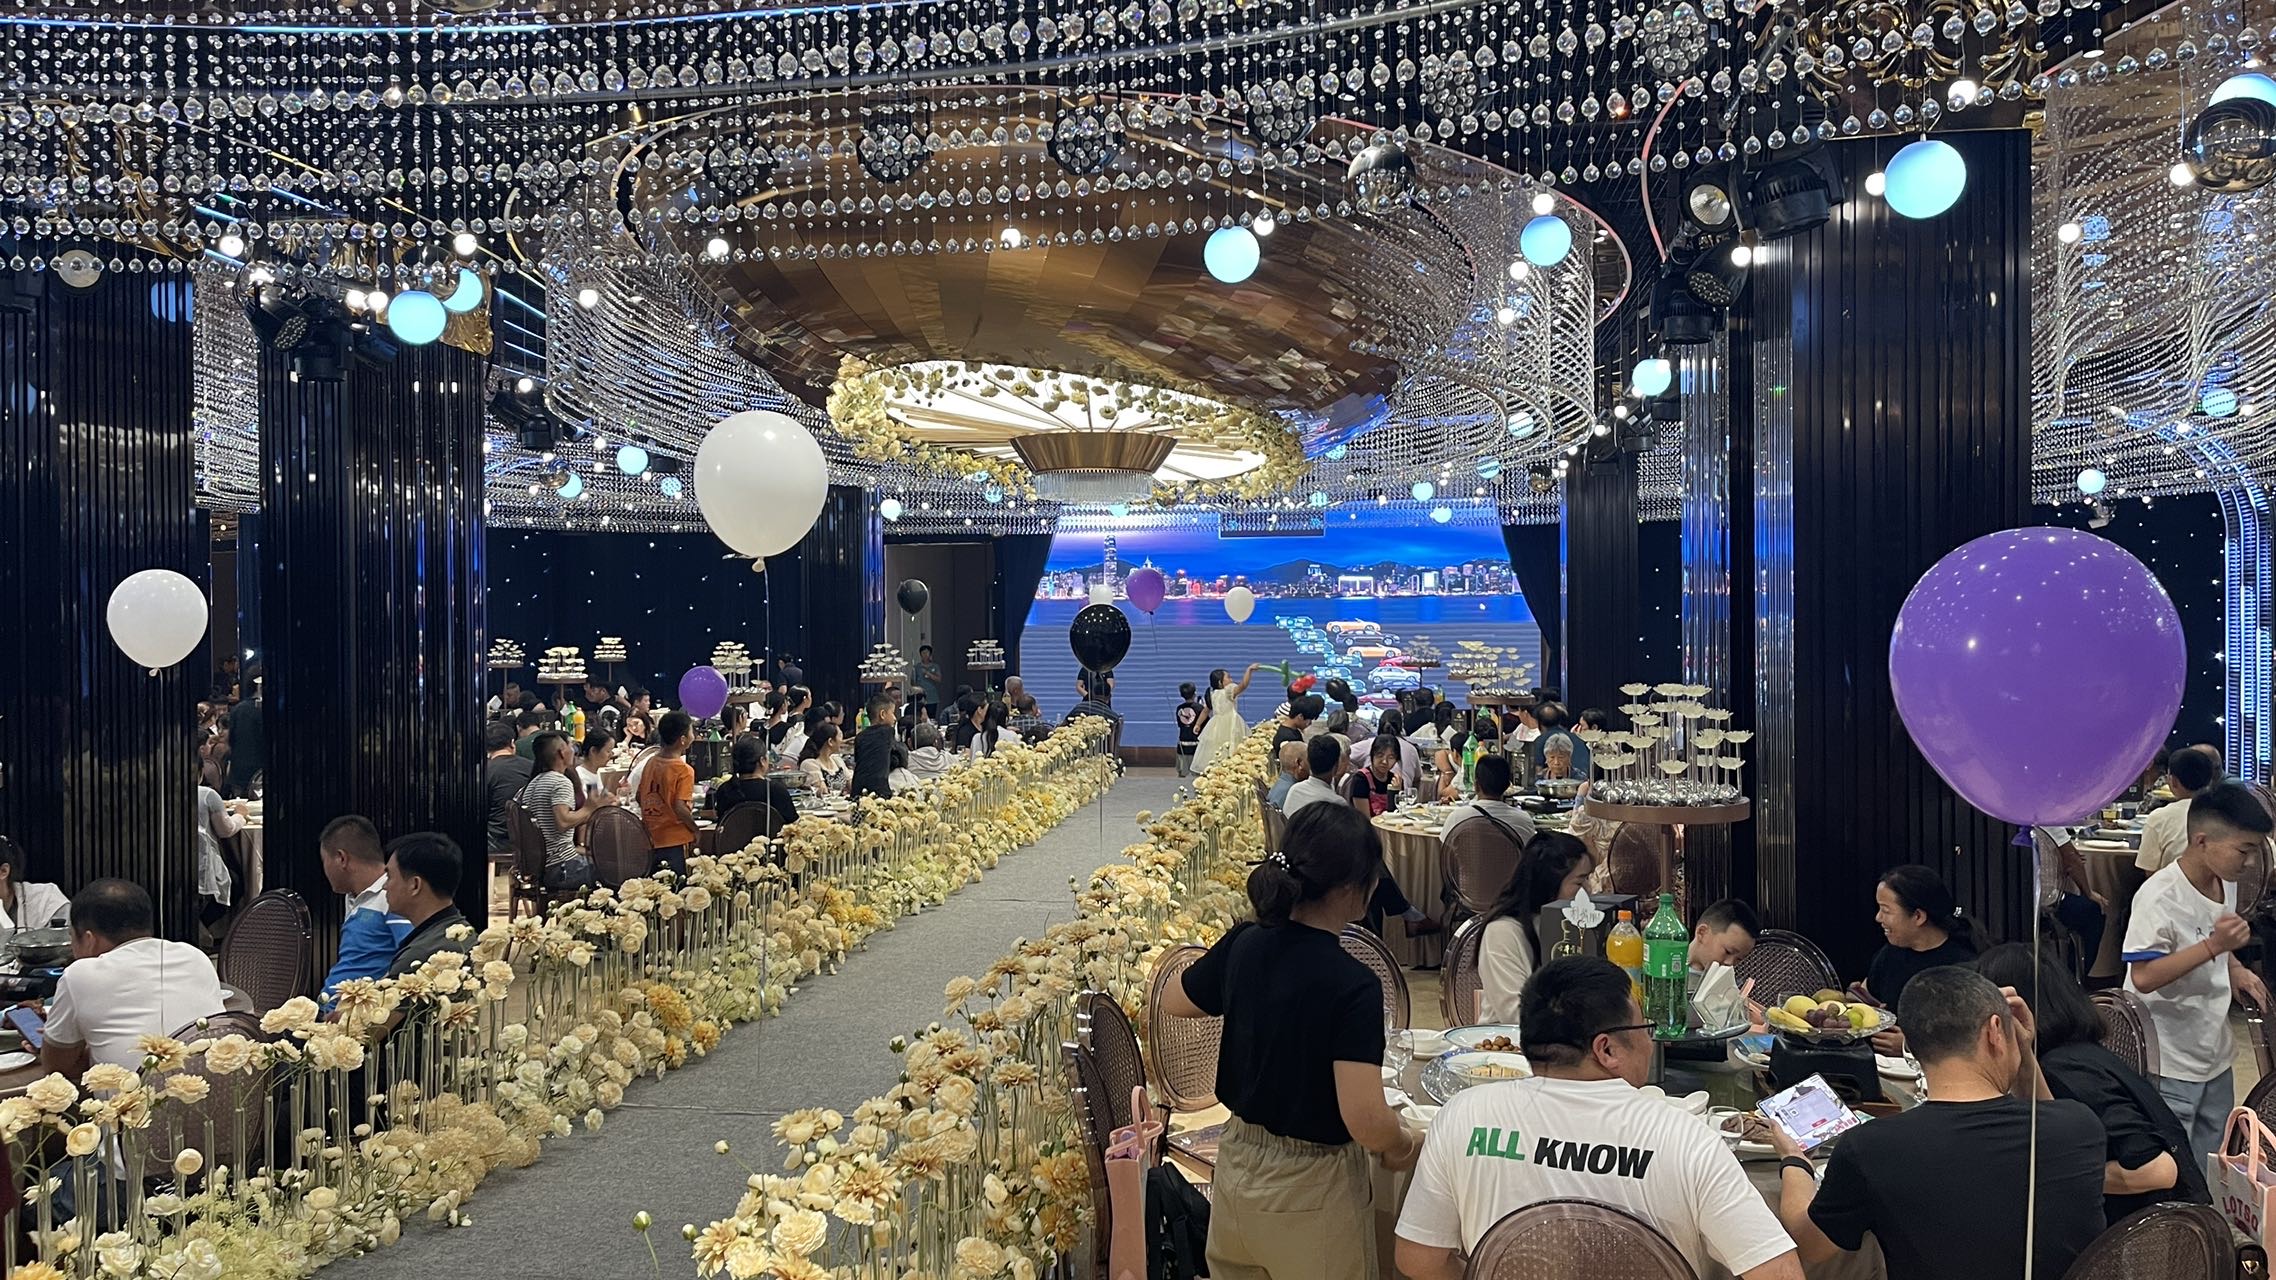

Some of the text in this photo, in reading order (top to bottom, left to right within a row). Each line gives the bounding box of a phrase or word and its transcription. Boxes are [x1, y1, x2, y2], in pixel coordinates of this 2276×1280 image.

[1466, 1127, 1655, 1180] ALL KNOW
[2222, 1195, 2259, 1232] LOTSO
